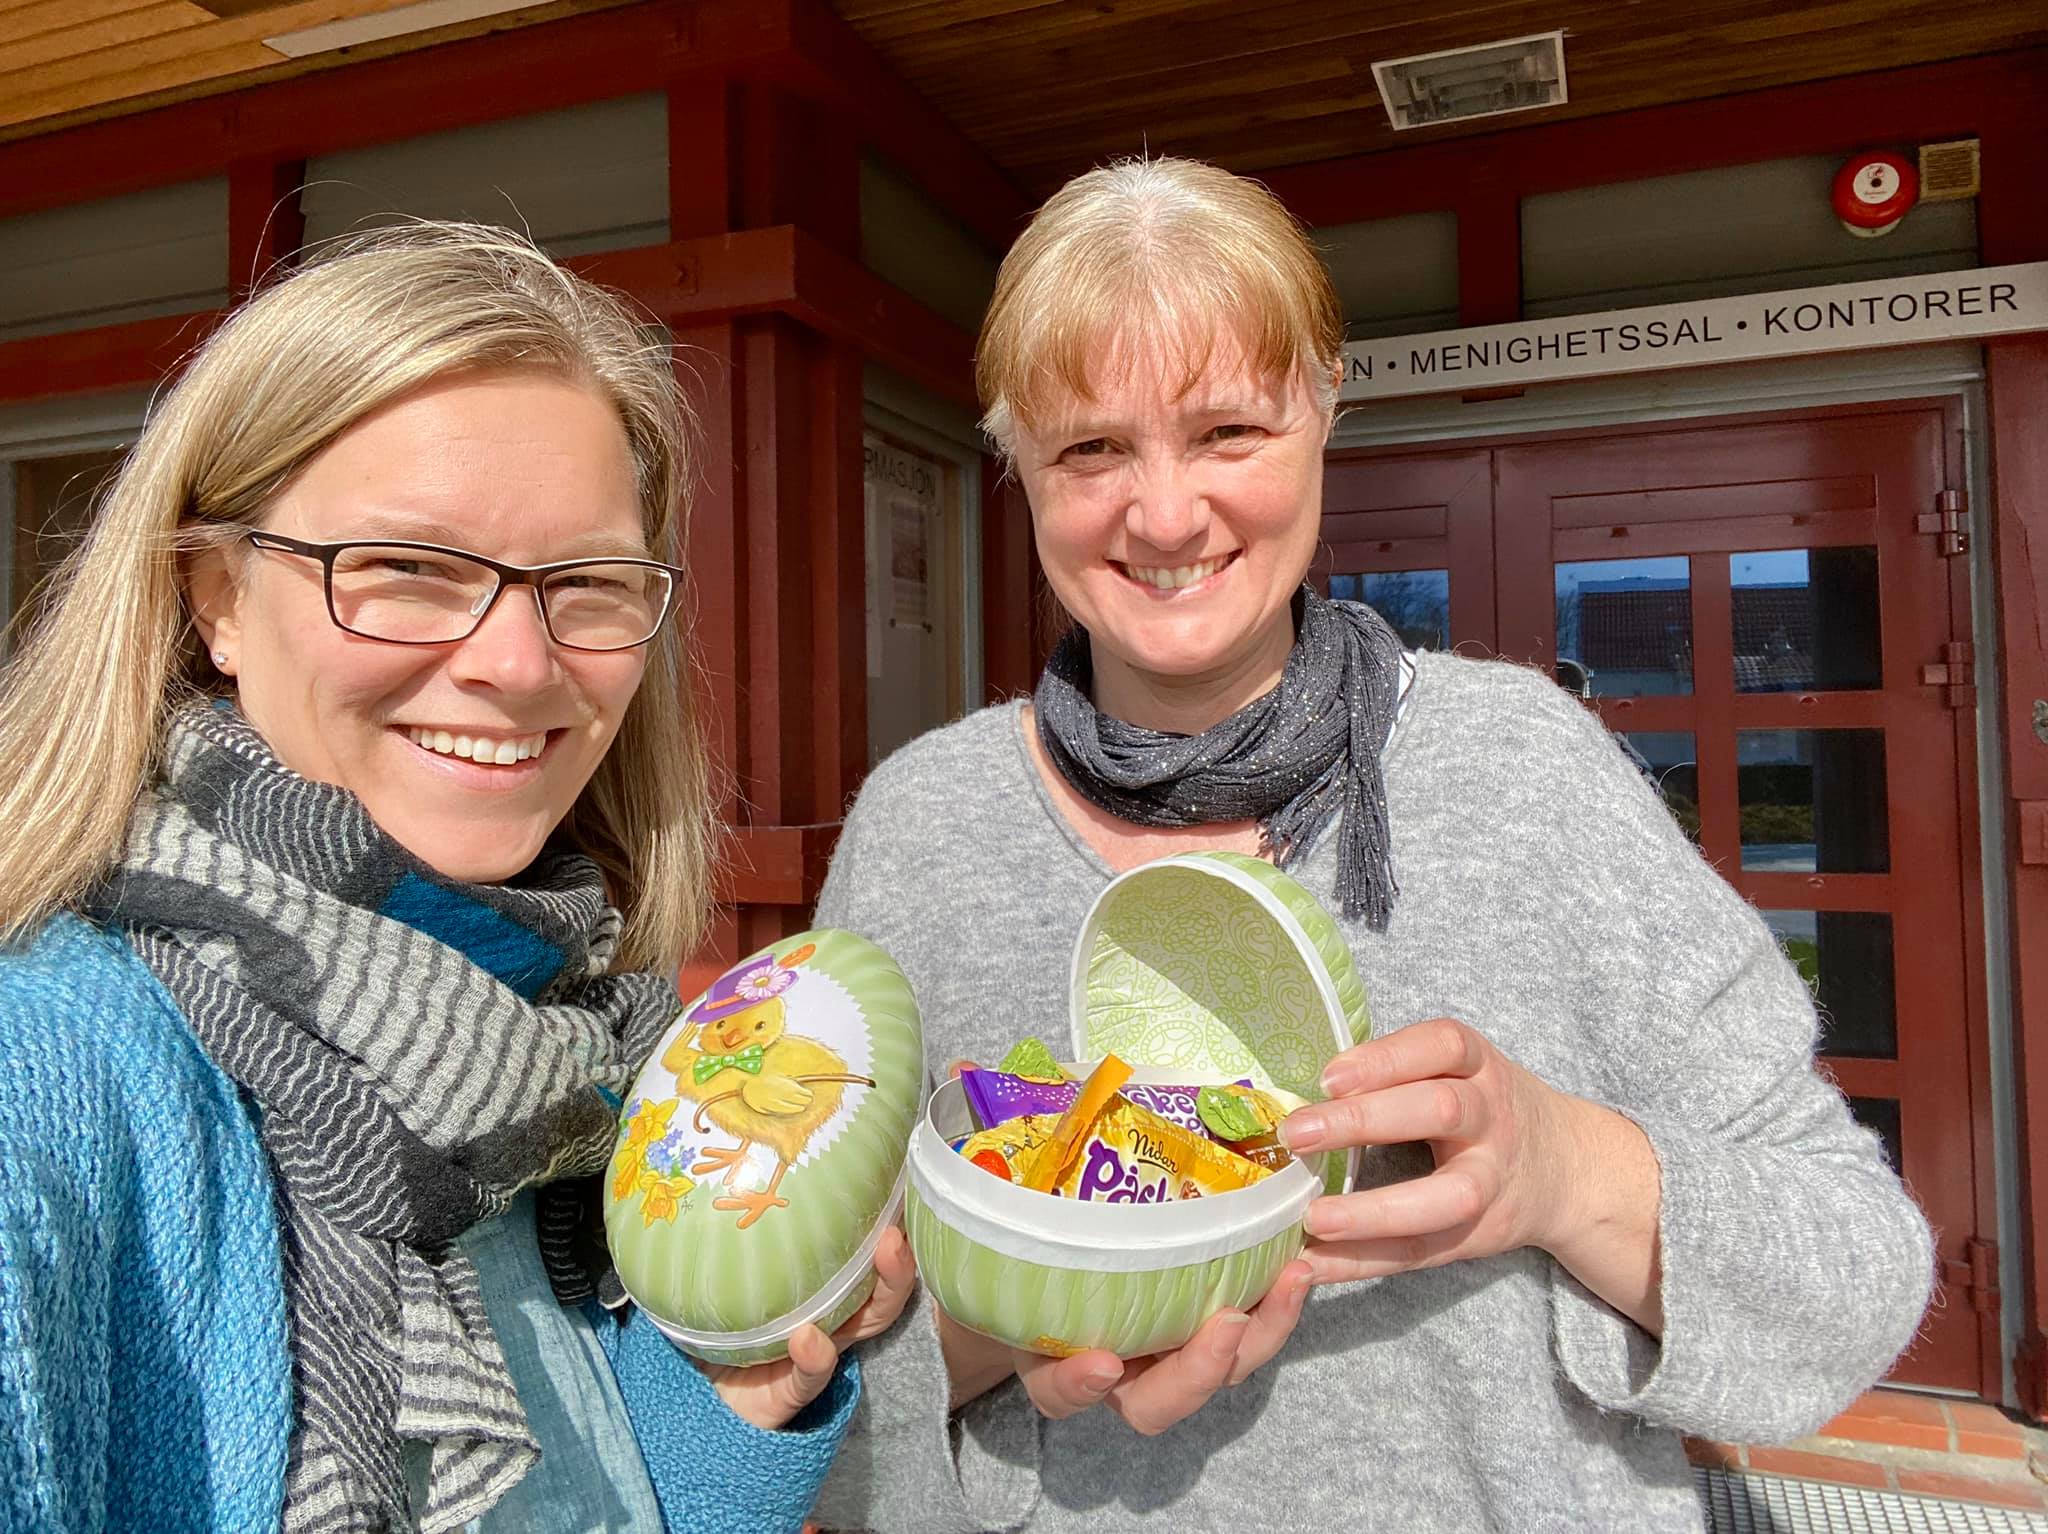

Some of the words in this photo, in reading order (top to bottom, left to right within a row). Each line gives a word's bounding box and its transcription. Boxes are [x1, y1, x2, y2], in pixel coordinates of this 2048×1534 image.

[1342, 355, 1373, 382] N
[1410, 315, 1723, 376] MENIGHETSSAL
[1763, 283, 2019, 336] KONTORER
[1127, 1128, 1179, 1173] Nidar
